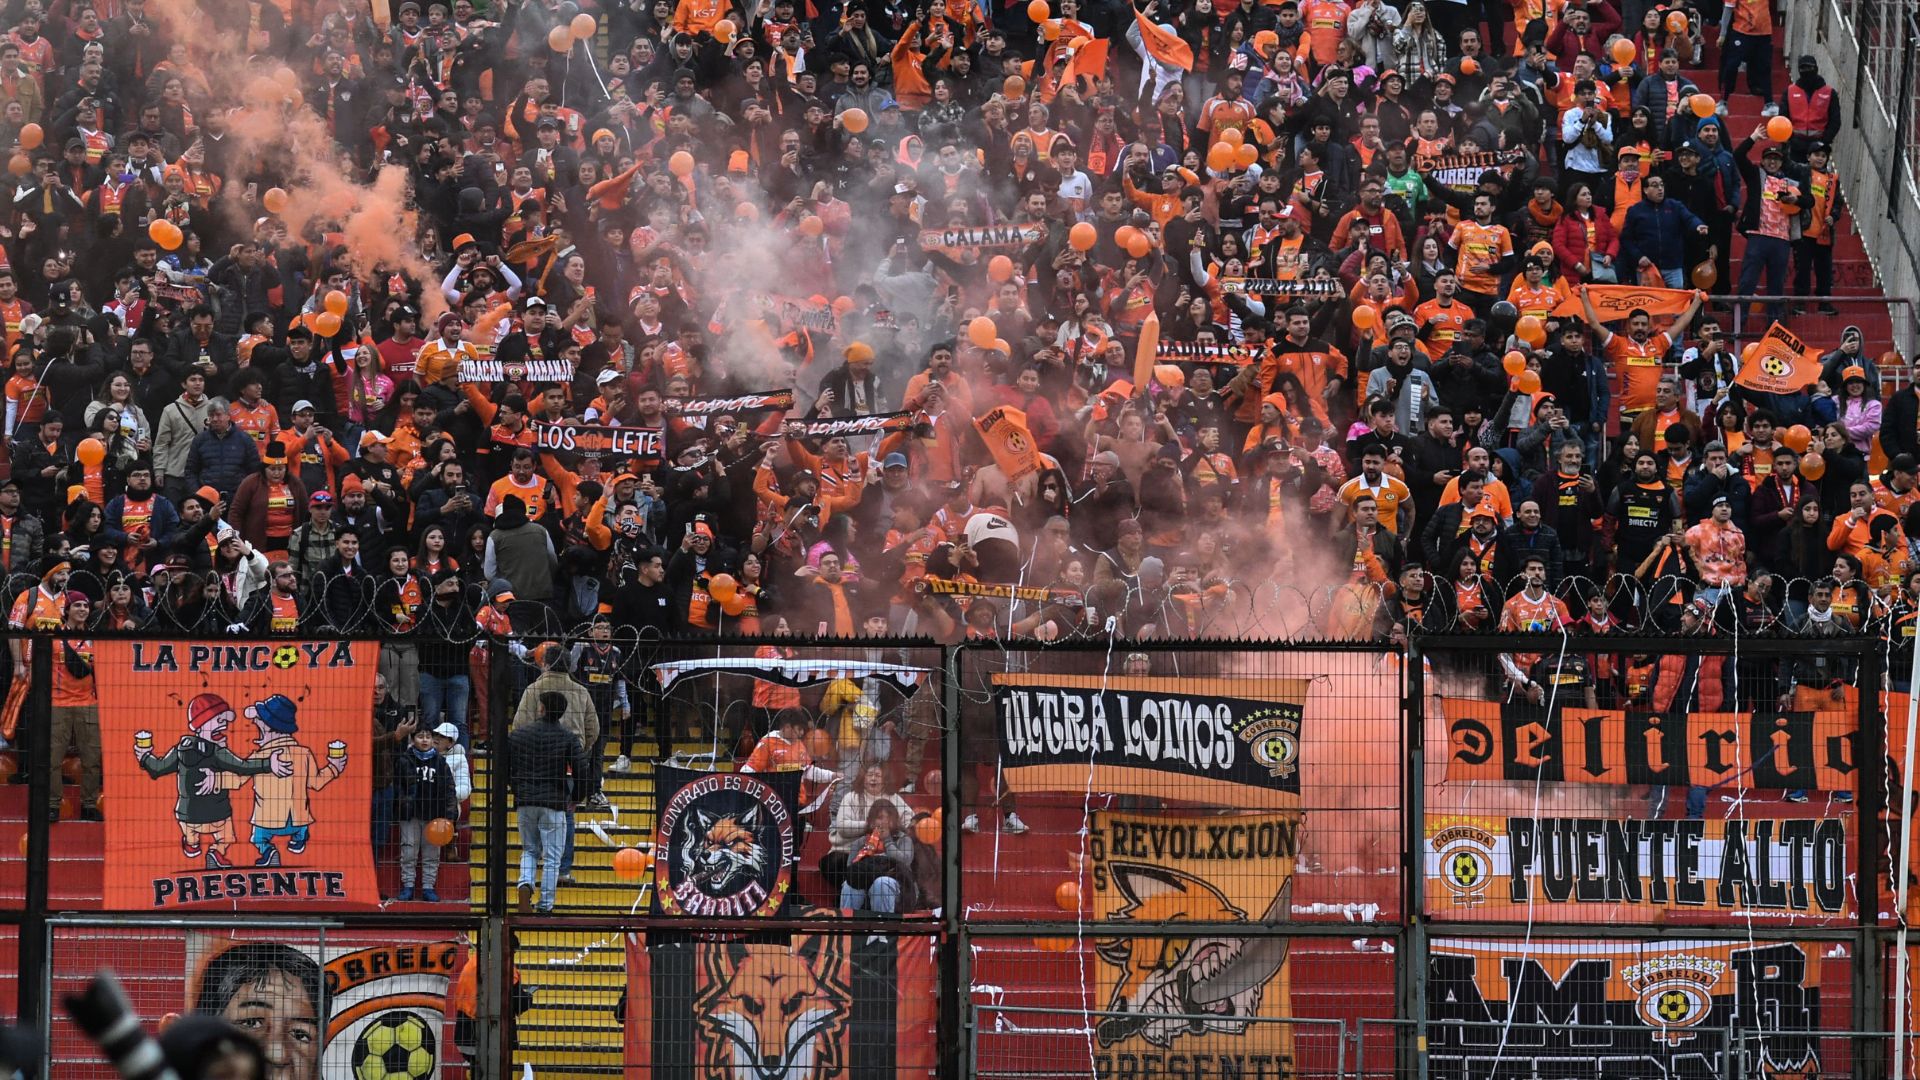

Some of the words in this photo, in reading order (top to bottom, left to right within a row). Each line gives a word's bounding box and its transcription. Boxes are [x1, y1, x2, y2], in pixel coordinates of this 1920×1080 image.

[943, 226, 1023, 247] CALAMA
[1244, 279, 1300, 294] PUENTE
[1303, 279, 1337, 294] ALTO
[525, 359, 574, 382] NARANJA
[538, 425, 576, 451] LOS
[612, 430, 658, 455] LETE
[1628, 518, 1658, 528] DIRECTV
[132, 642, 179, 672] LA
[1002, 689, 1114, 756] ULTRA
[1245, 720, 1292, 738] COBRELOA
[723, 775, 742, 791] ES
[744, 779, 765, 799] DE
[661, 777, 719, 837] CONTRATO
[763, 792, 789, 824] POR
[781, 825, 795, 867] VIDA
[1110, 819, 1299, 860] REVOLXCION
[1435, 829, 1490, 848] COBRELOA
[657, 841, 670, 862] EL
[1508, 816, 1705, 905] PUENTE
[1718, 817, 1846, 913] ALTO
[153, 871, 346, 907] PRESENTE
[1637, 968, 1709, 988] COBRELOA
